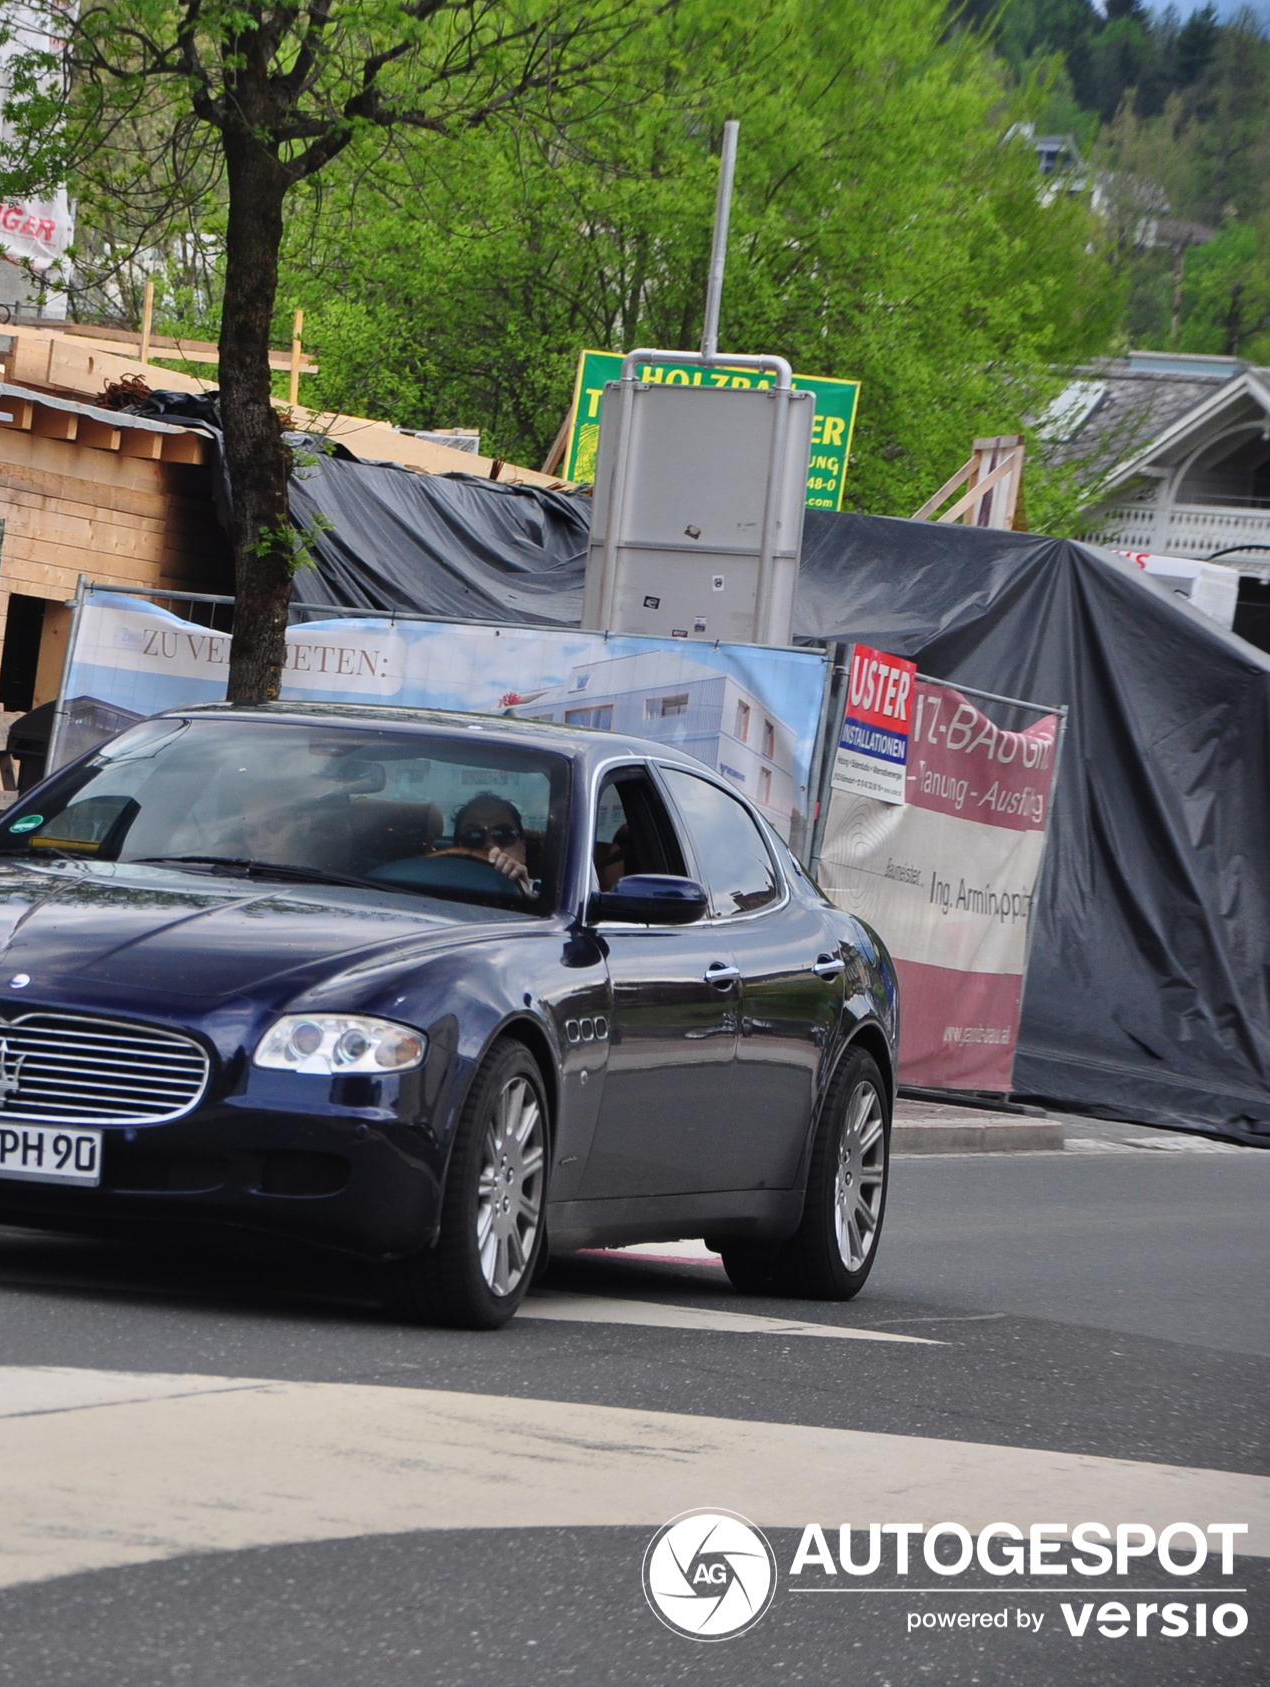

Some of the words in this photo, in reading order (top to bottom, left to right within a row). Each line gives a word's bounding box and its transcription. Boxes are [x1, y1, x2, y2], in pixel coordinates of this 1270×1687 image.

[585, 388, 603, 418] T
[810, 415, 846, 446] ER
[808, 456, 839, 476] UNG
[807, 477, 837, 491] 48-0
[804, 497, 833, 508] .com
[143, 629, 179, 658] ZU
[851, 656, 910, 721] USTER
[841, 723, 906, 759] INSTALLATIONEN
[930, 871, 953, 915] Ing.
[52, 1134, 96, 1172] 90
